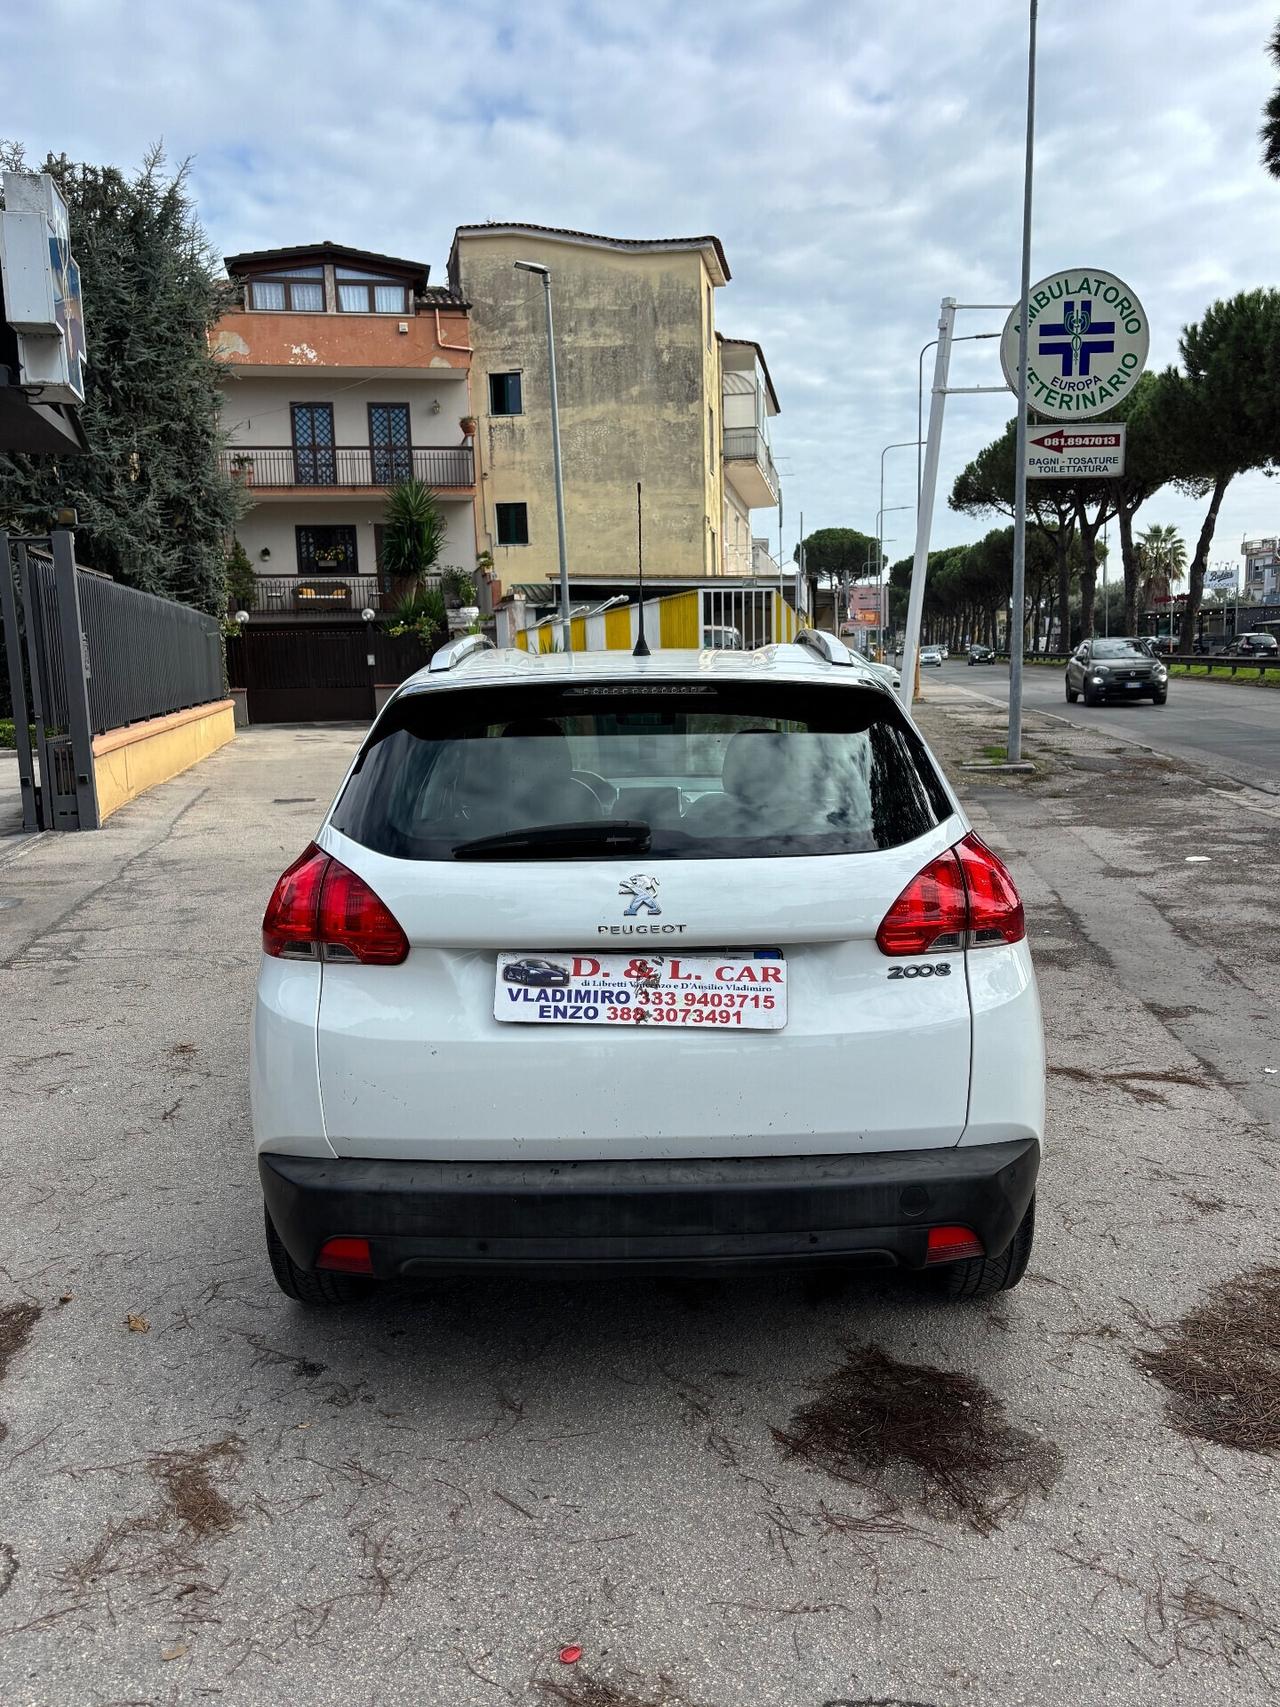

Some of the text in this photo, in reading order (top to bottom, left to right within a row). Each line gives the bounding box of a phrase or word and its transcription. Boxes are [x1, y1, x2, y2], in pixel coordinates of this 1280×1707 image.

[1016, 352, 1138, 411] ETERINARIO
[1050, 375, 1103, 392] EUROPA
[1044, 436, 1116, 447] 081.8947013
[1028, 457, 1060, 466] BAGNI
[1068, 456, 1119, 465] TOSATURE
[1038, 465, 1109, 474] TOILETTATURA
[597, 924, 687, 935] PEUGEOT
[570, 957, 610, 979] D.
[669, 960, 702, 981] L.
[715, 966, 783, 983] CAR
[887, 962, 952, 980] 2008
[592, 980, 627, 988] Libretti
[725, 984, 772, 992] Vladimiro
[508, 988, 775, 1009] VLADIMIRO 333 9403715
[538, 1005, 599, 1020] ENZO
[653, 1007, 742, 1024] 3073491
